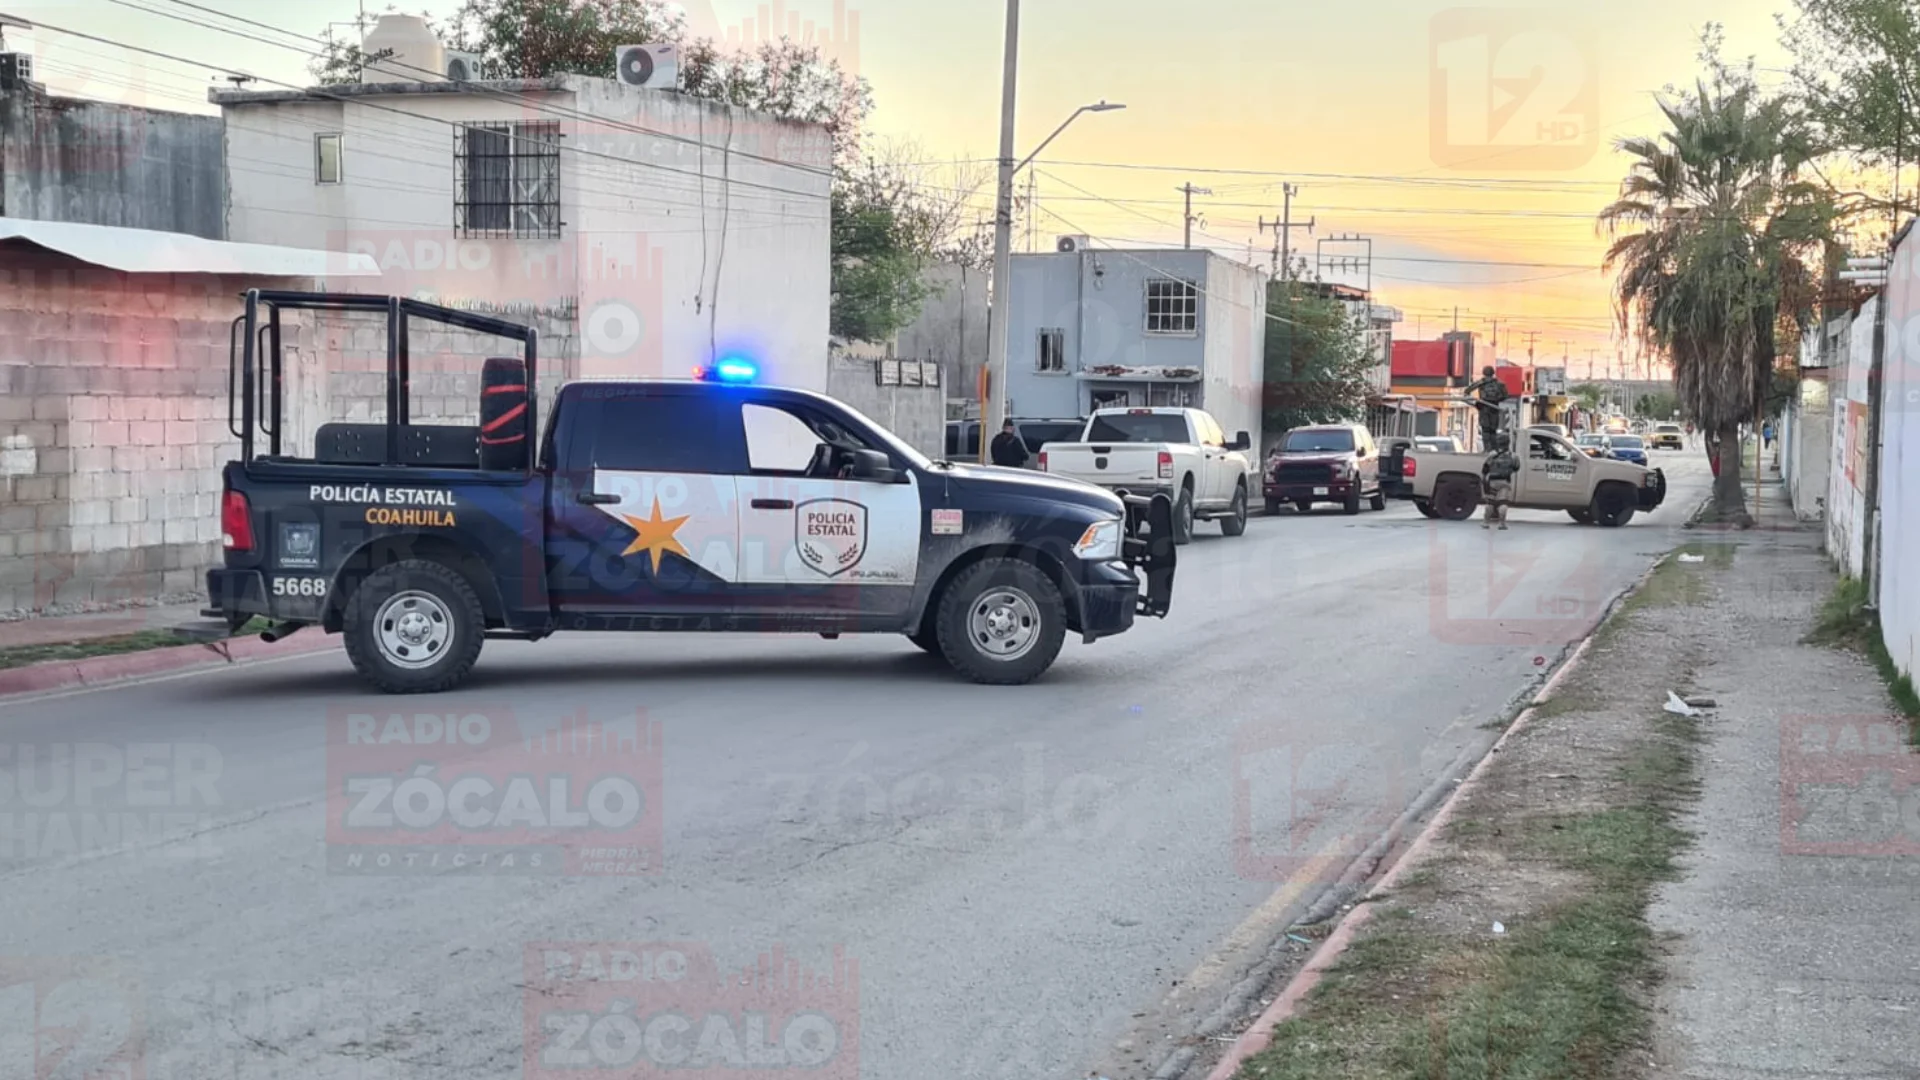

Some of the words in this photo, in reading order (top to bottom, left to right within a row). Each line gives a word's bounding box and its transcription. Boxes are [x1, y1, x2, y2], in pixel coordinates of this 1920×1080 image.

[310, 483, 380, 503] POLICÍA
[385, 488, 457, 505] ESTATAL
[365, 508, 456, 526] COAHUILA
[808, 524, 857, 536] ESTATAL
[272, 577, 326, 596] 5668
